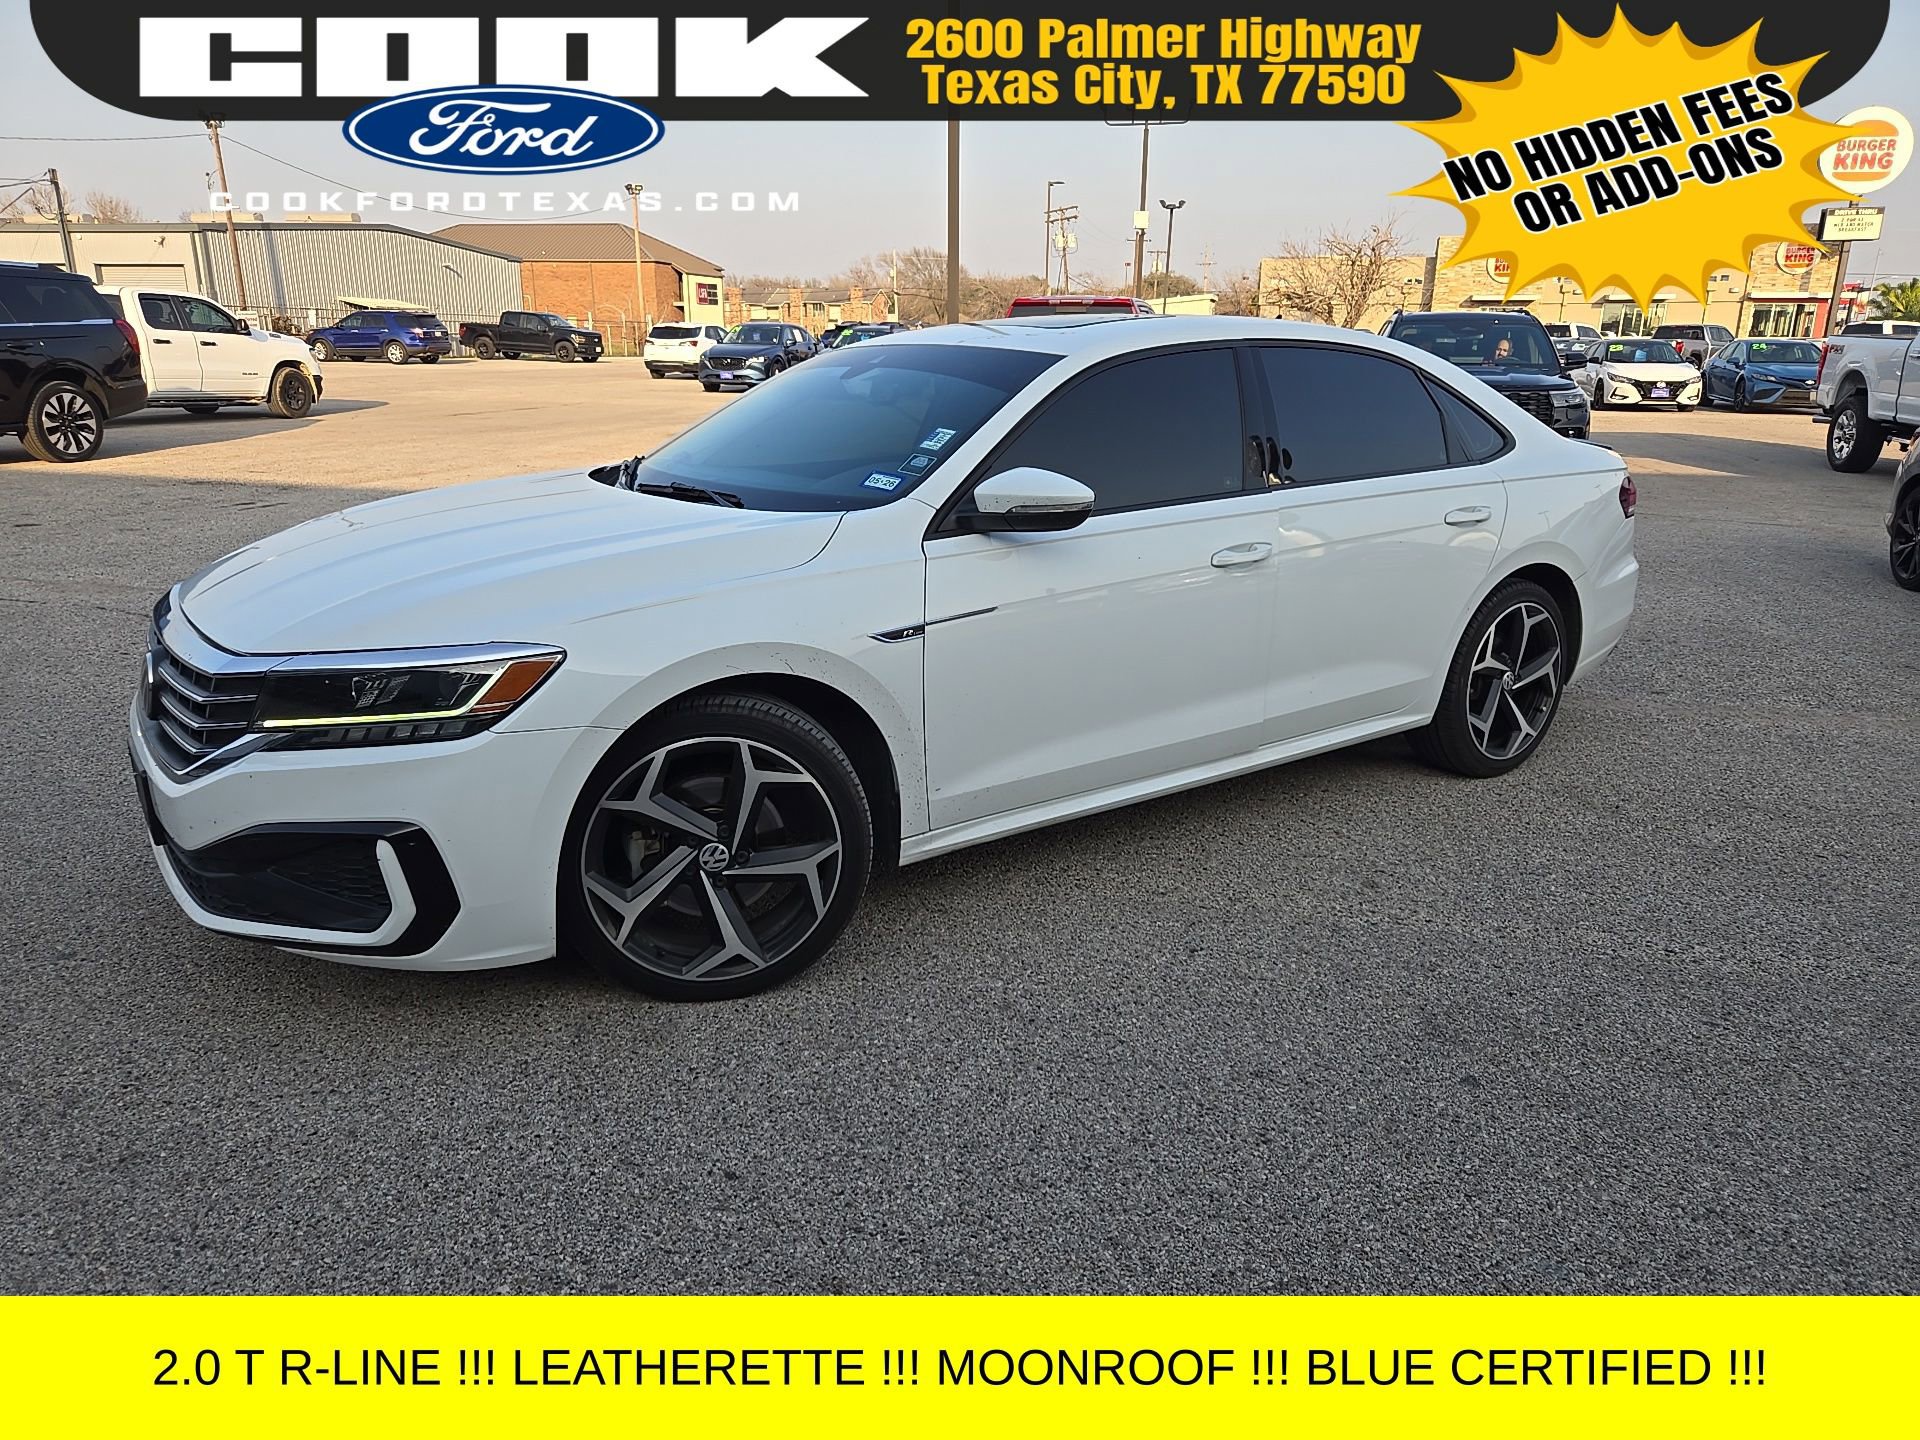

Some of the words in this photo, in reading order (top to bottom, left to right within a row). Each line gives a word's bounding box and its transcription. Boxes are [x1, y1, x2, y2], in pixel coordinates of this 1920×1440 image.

[1837, 138, 1897, 152] BURGER
[1832, 152, 1895, 171] KING
[1784, 253, 1815, 263] KING
